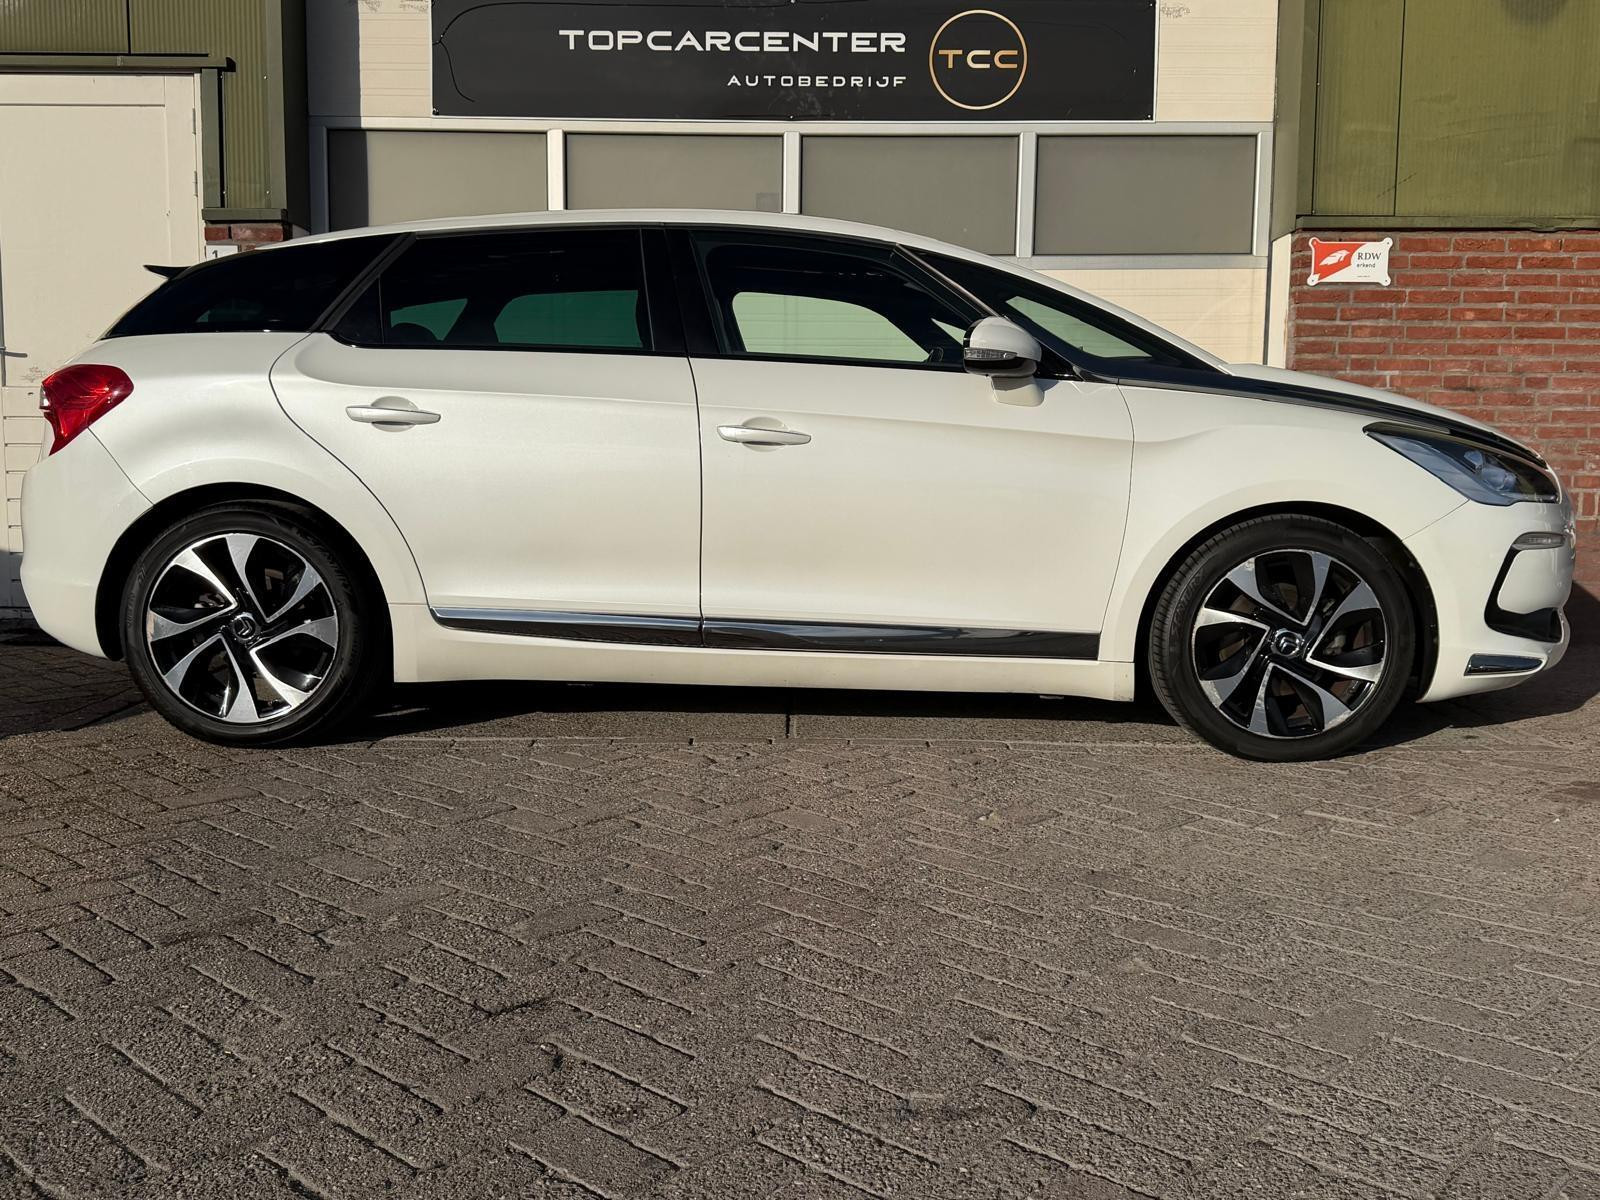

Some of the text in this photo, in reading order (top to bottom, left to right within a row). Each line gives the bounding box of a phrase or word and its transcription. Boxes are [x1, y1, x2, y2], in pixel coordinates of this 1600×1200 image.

[558, 29, 907, 52] TOPCARCENTER
[938, 49, 1018, 69] TCC
[727, 75, 907, 88] AUTOBEDRIJF
[1357, 252, 1382, 260] RDW
